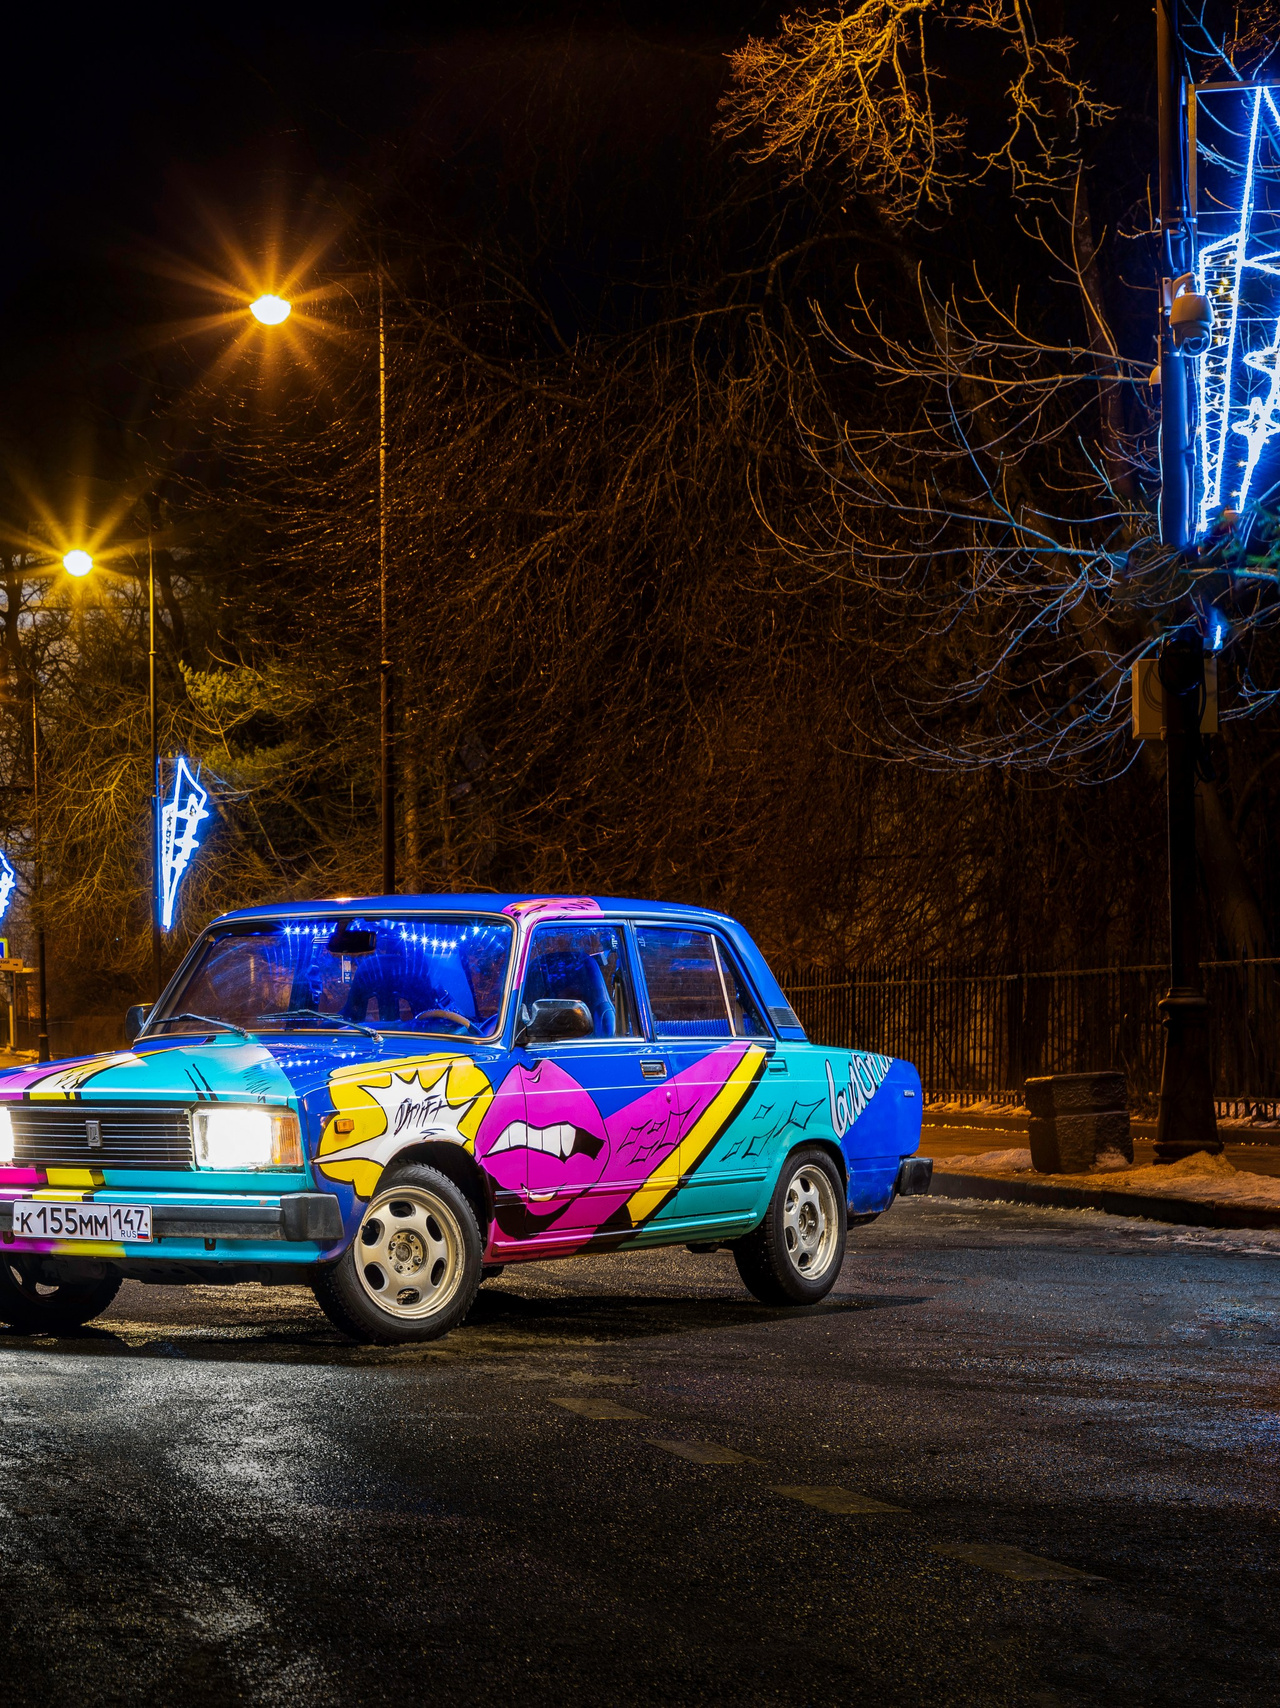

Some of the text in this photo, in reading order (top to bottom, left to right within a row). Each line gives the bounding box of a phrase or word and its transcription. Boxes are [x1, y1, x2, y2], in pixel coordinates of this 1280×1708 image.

[21, 1206, 144, 1236] К155ММ 147
[120, 1229, 137, 1238] RUS
